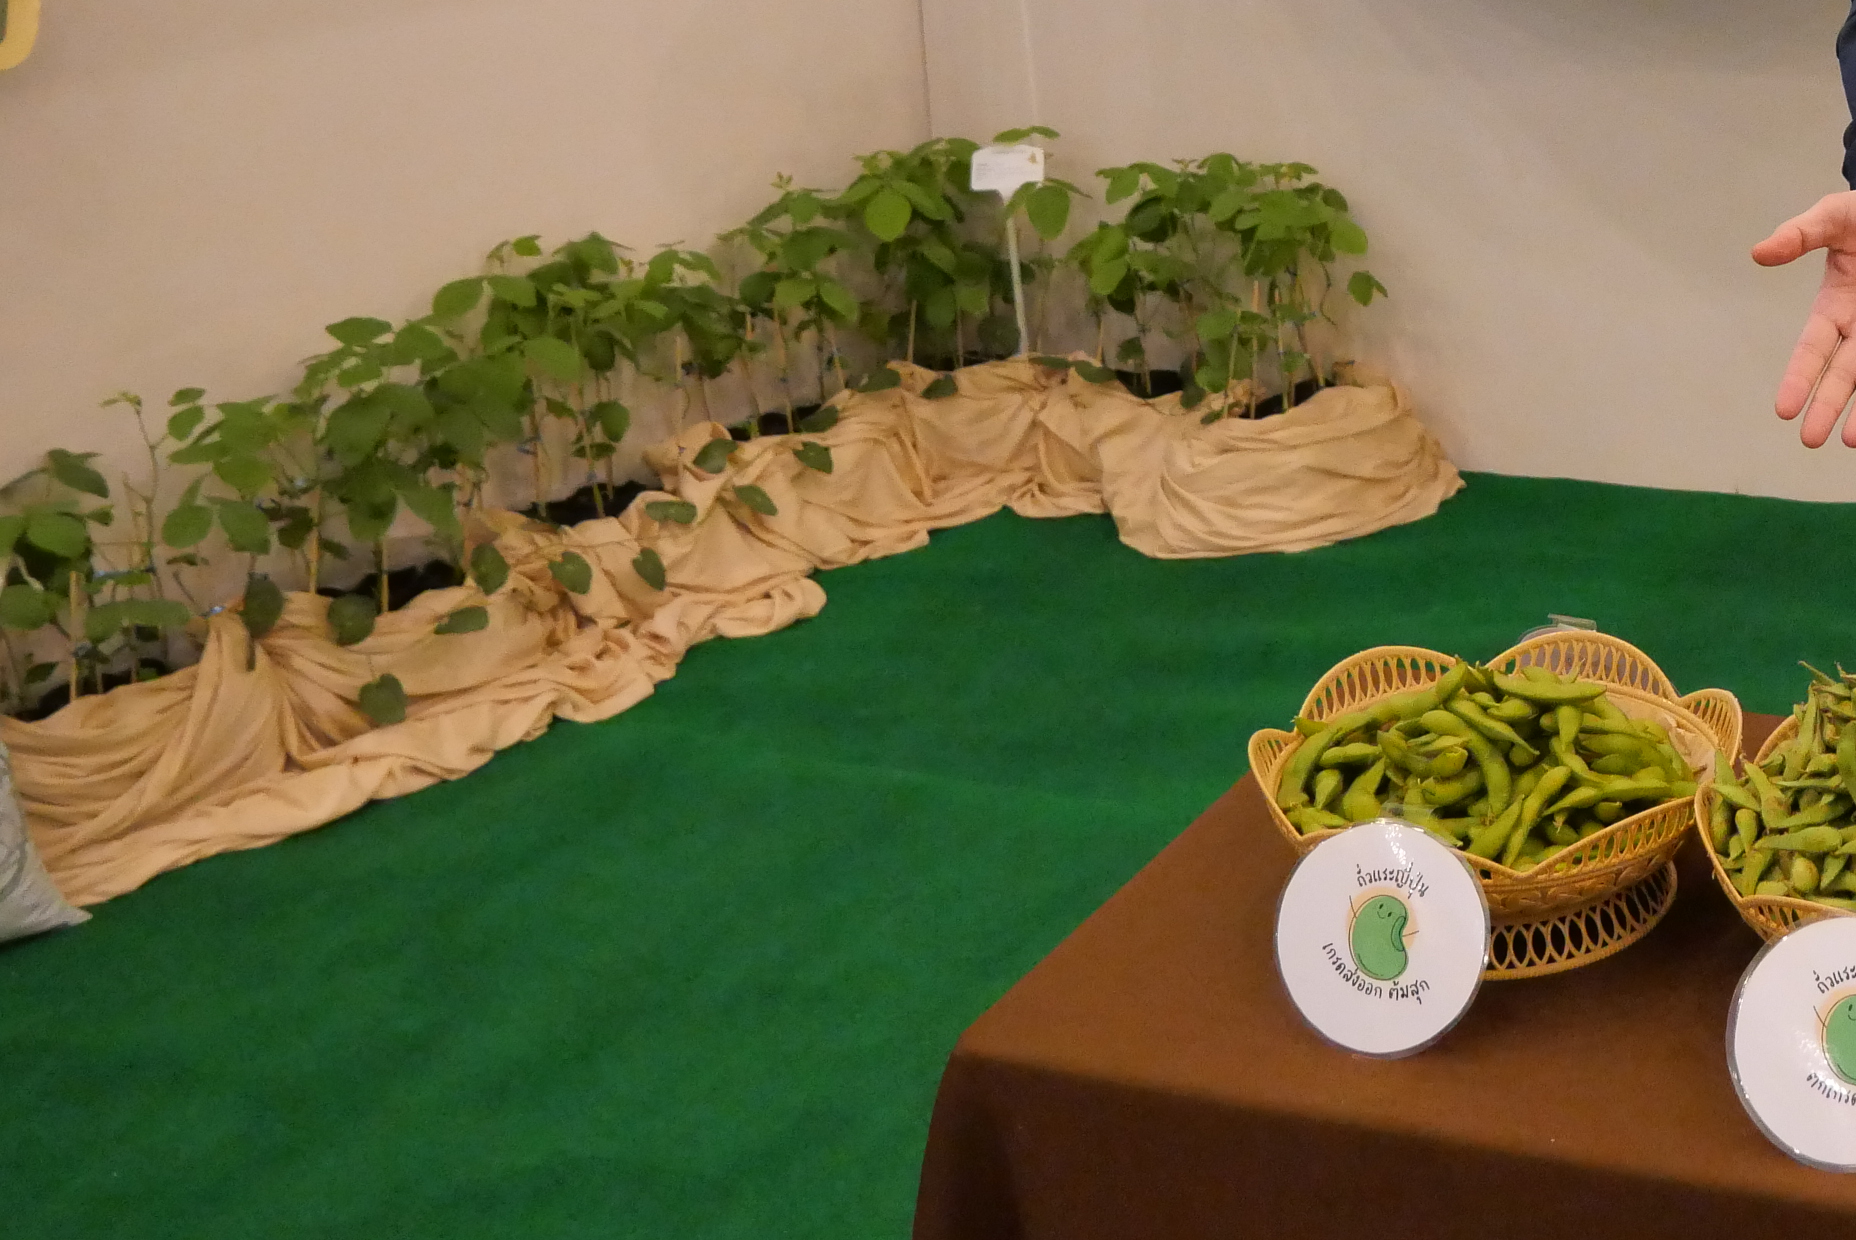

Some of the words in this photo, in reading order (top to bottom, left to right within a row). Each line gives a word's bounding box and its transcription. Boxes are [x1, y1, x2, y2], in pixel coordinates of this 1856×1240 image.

[1355, 862, 1429, 900] ถั่วแระญี่ปุ่น
[1322, 942, 1383, 999] เกรดส่งออก
[1388, 980, 1430, 1005] ต้มสุก
